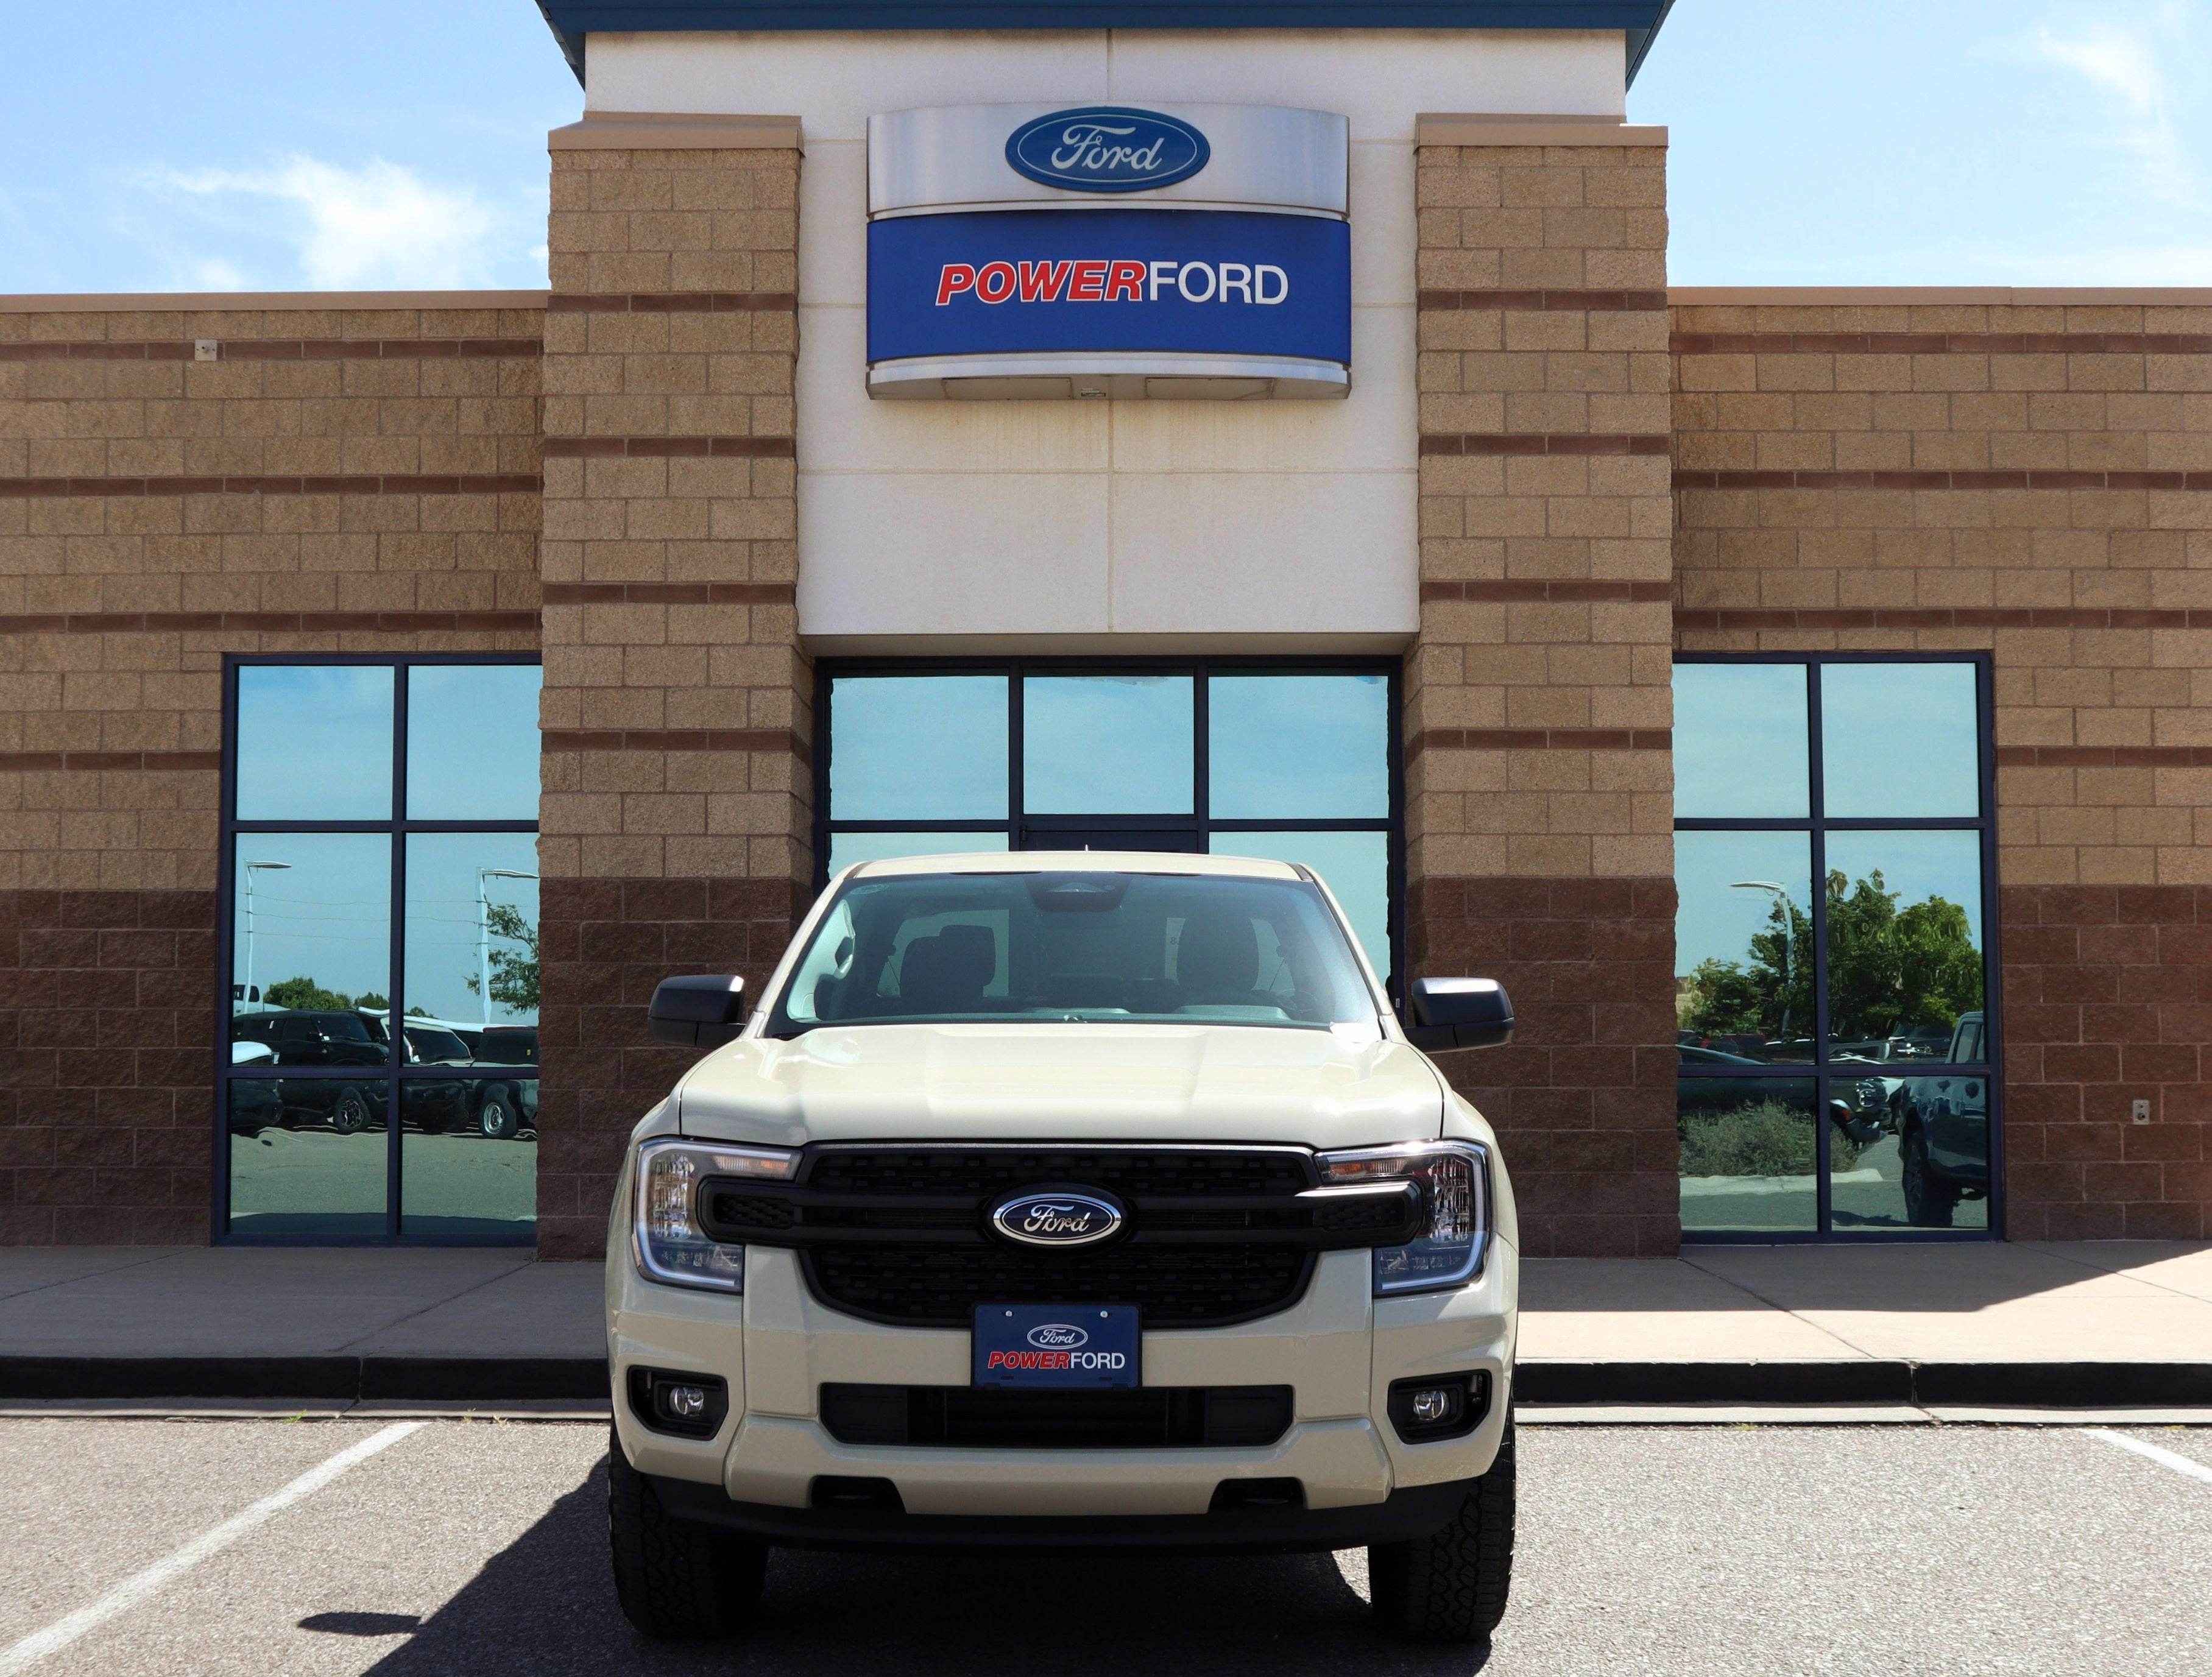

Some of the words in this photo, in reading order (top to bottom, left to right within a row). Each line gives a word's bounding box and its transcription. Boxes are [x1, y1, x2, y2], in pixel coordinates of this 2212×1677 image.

[1051, 124, 1164, 171] Ford
[1023, 1204, 1091, 1232] Ford
[1039, 1329, 1076, 1344] Ford
